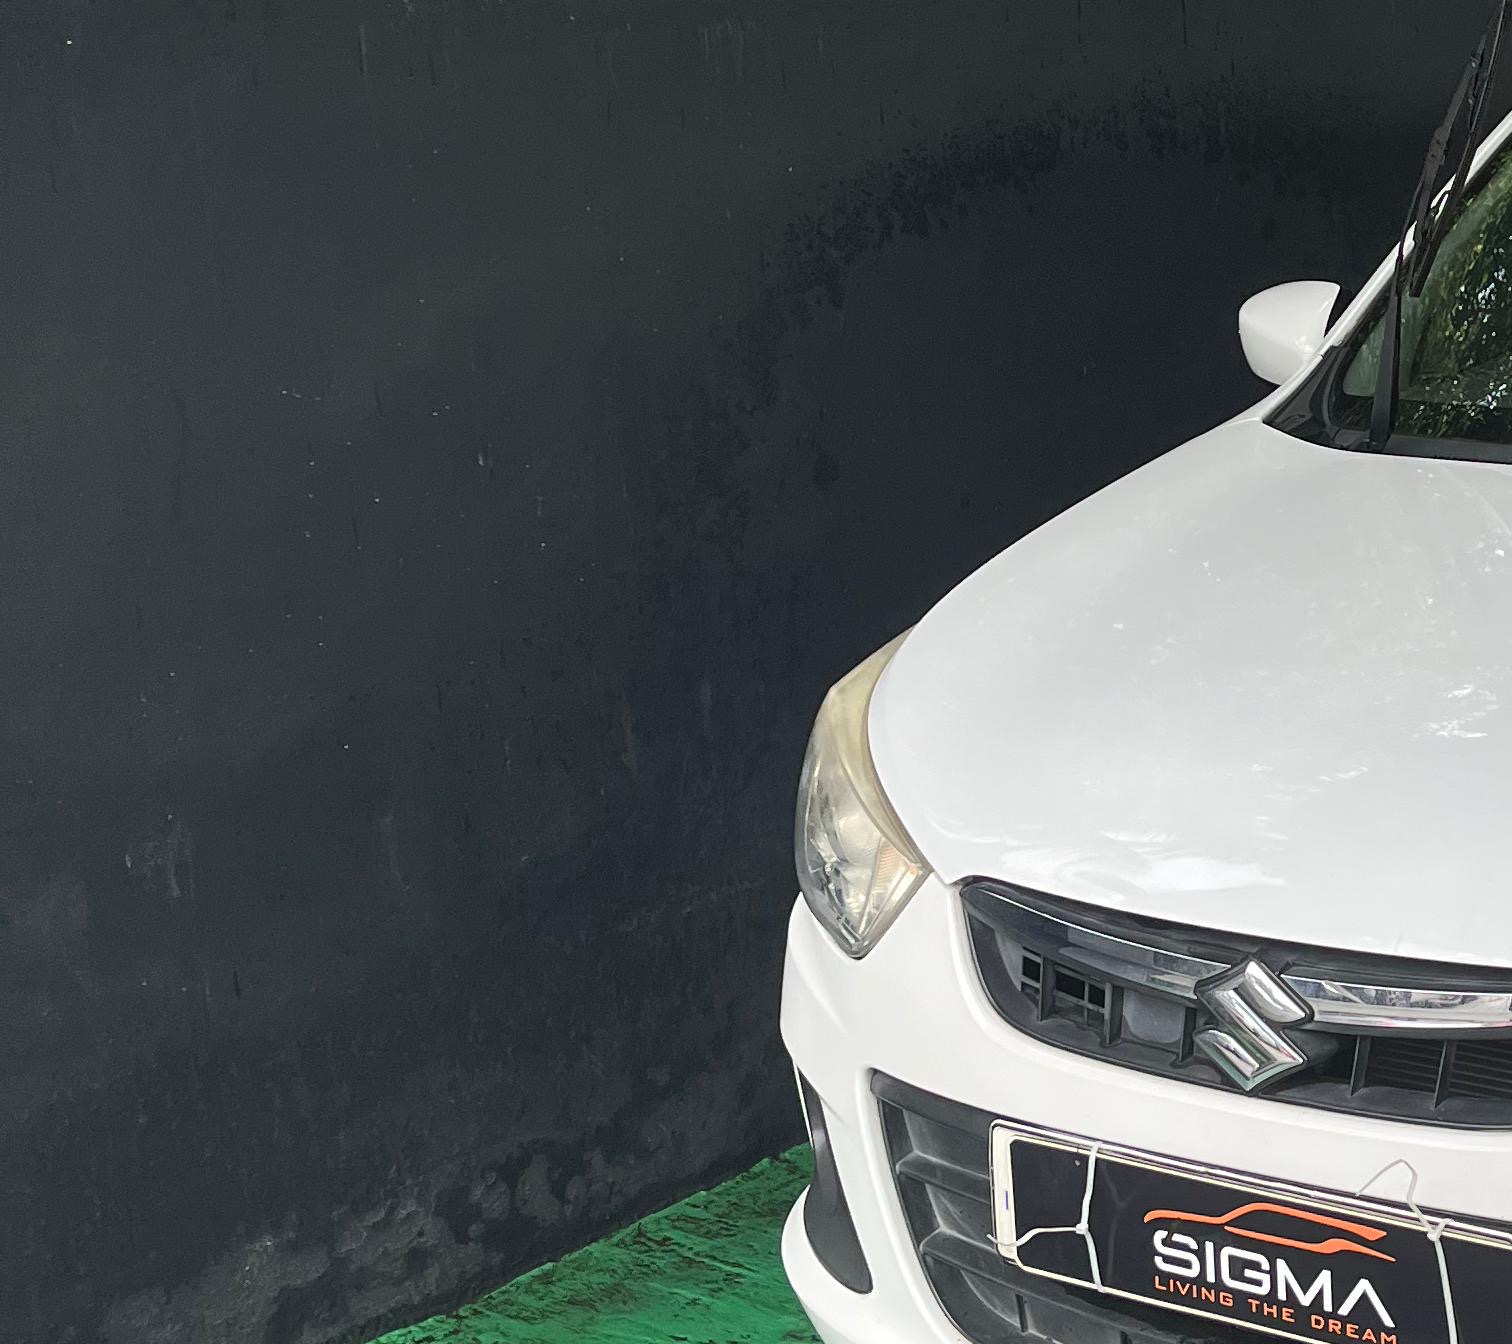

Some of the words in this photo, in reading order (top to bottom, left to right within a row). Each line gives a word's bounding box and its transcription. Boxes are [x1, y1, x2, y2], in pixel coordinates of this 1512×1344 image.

[1153, 1229, 1395, 1328] SIGMA
[1154, 1276, 1235, 1307] LIVING
[1248, 1298, 1295, 1323] THE
